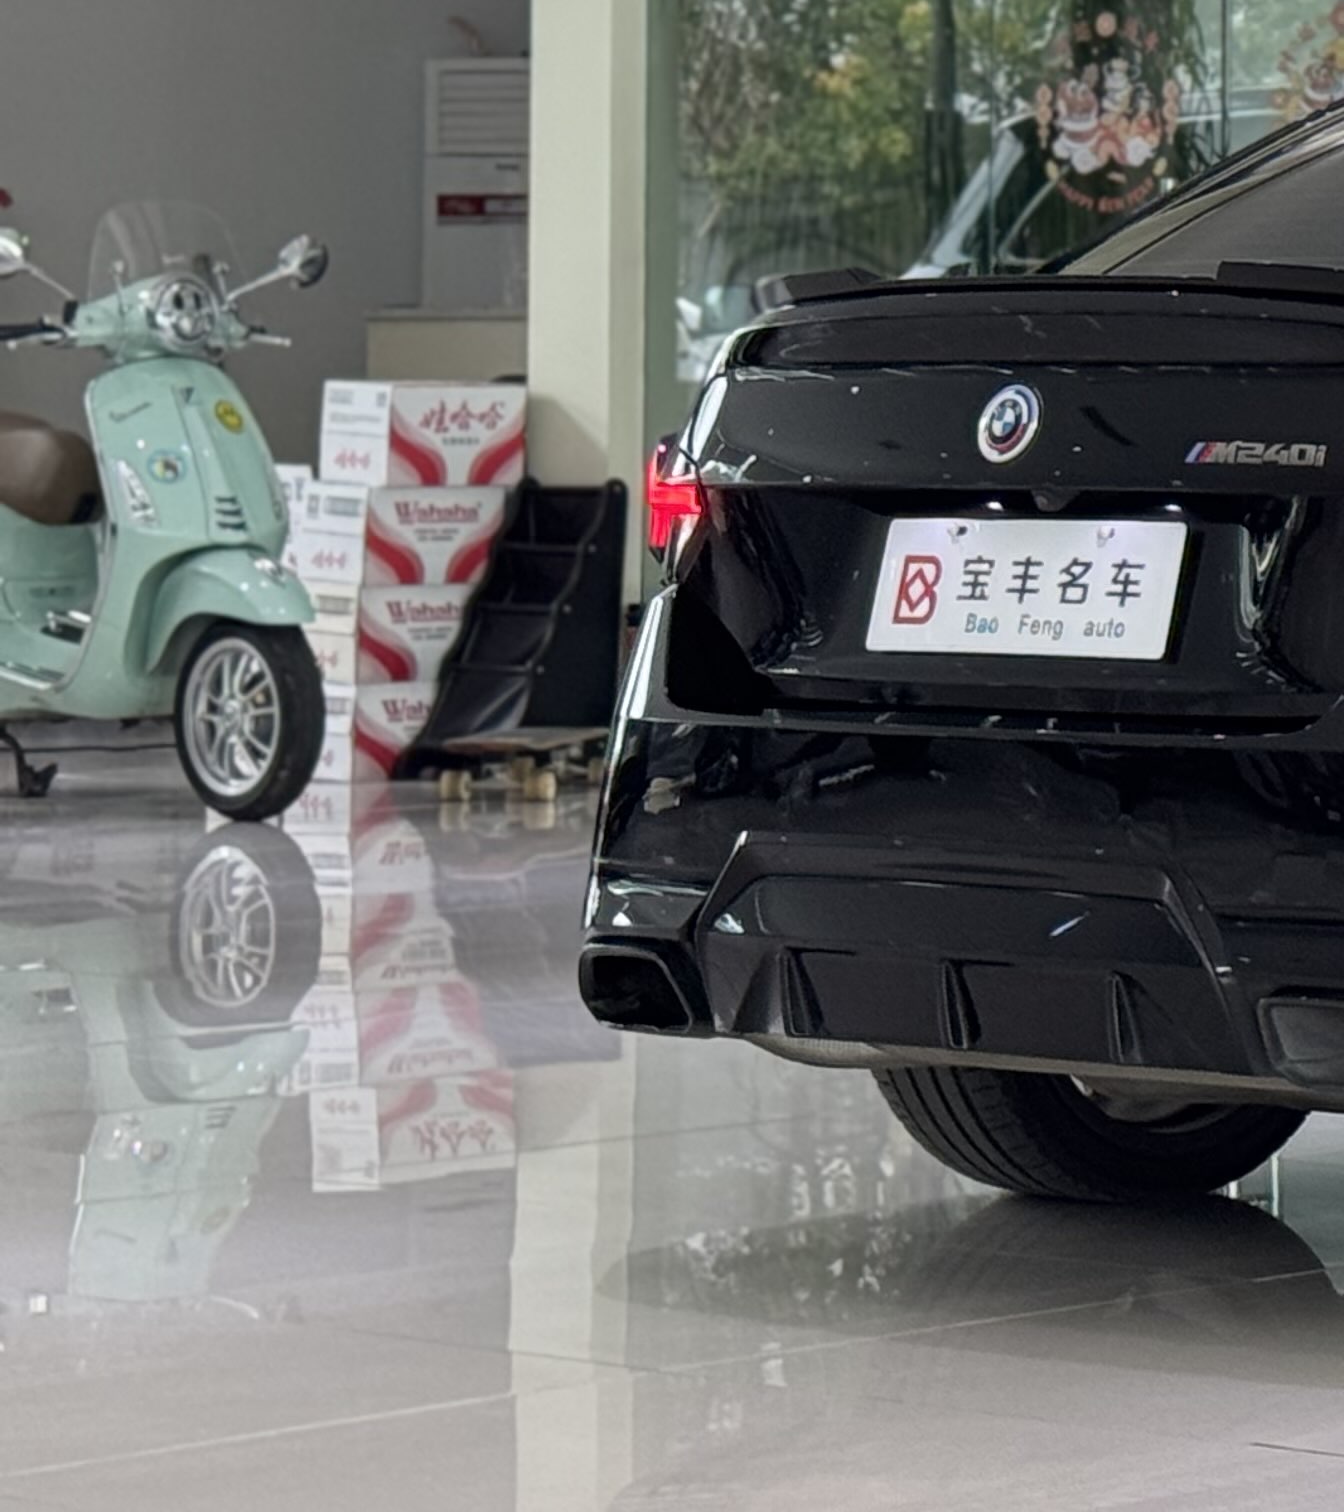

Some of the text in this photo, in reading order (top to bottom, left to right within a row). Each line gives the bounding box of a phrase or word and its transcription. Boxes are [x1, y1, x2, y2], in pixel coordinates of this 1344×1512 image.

[1203, 440, 1327, 467] M240i
[395, 501, 478, 525] Wahaha
[956, 555, 1145, 607] 宝丰名车
[386, 599, 461, 623] Wahah
[964, 613, 1126, 640] Bao Feng auto
